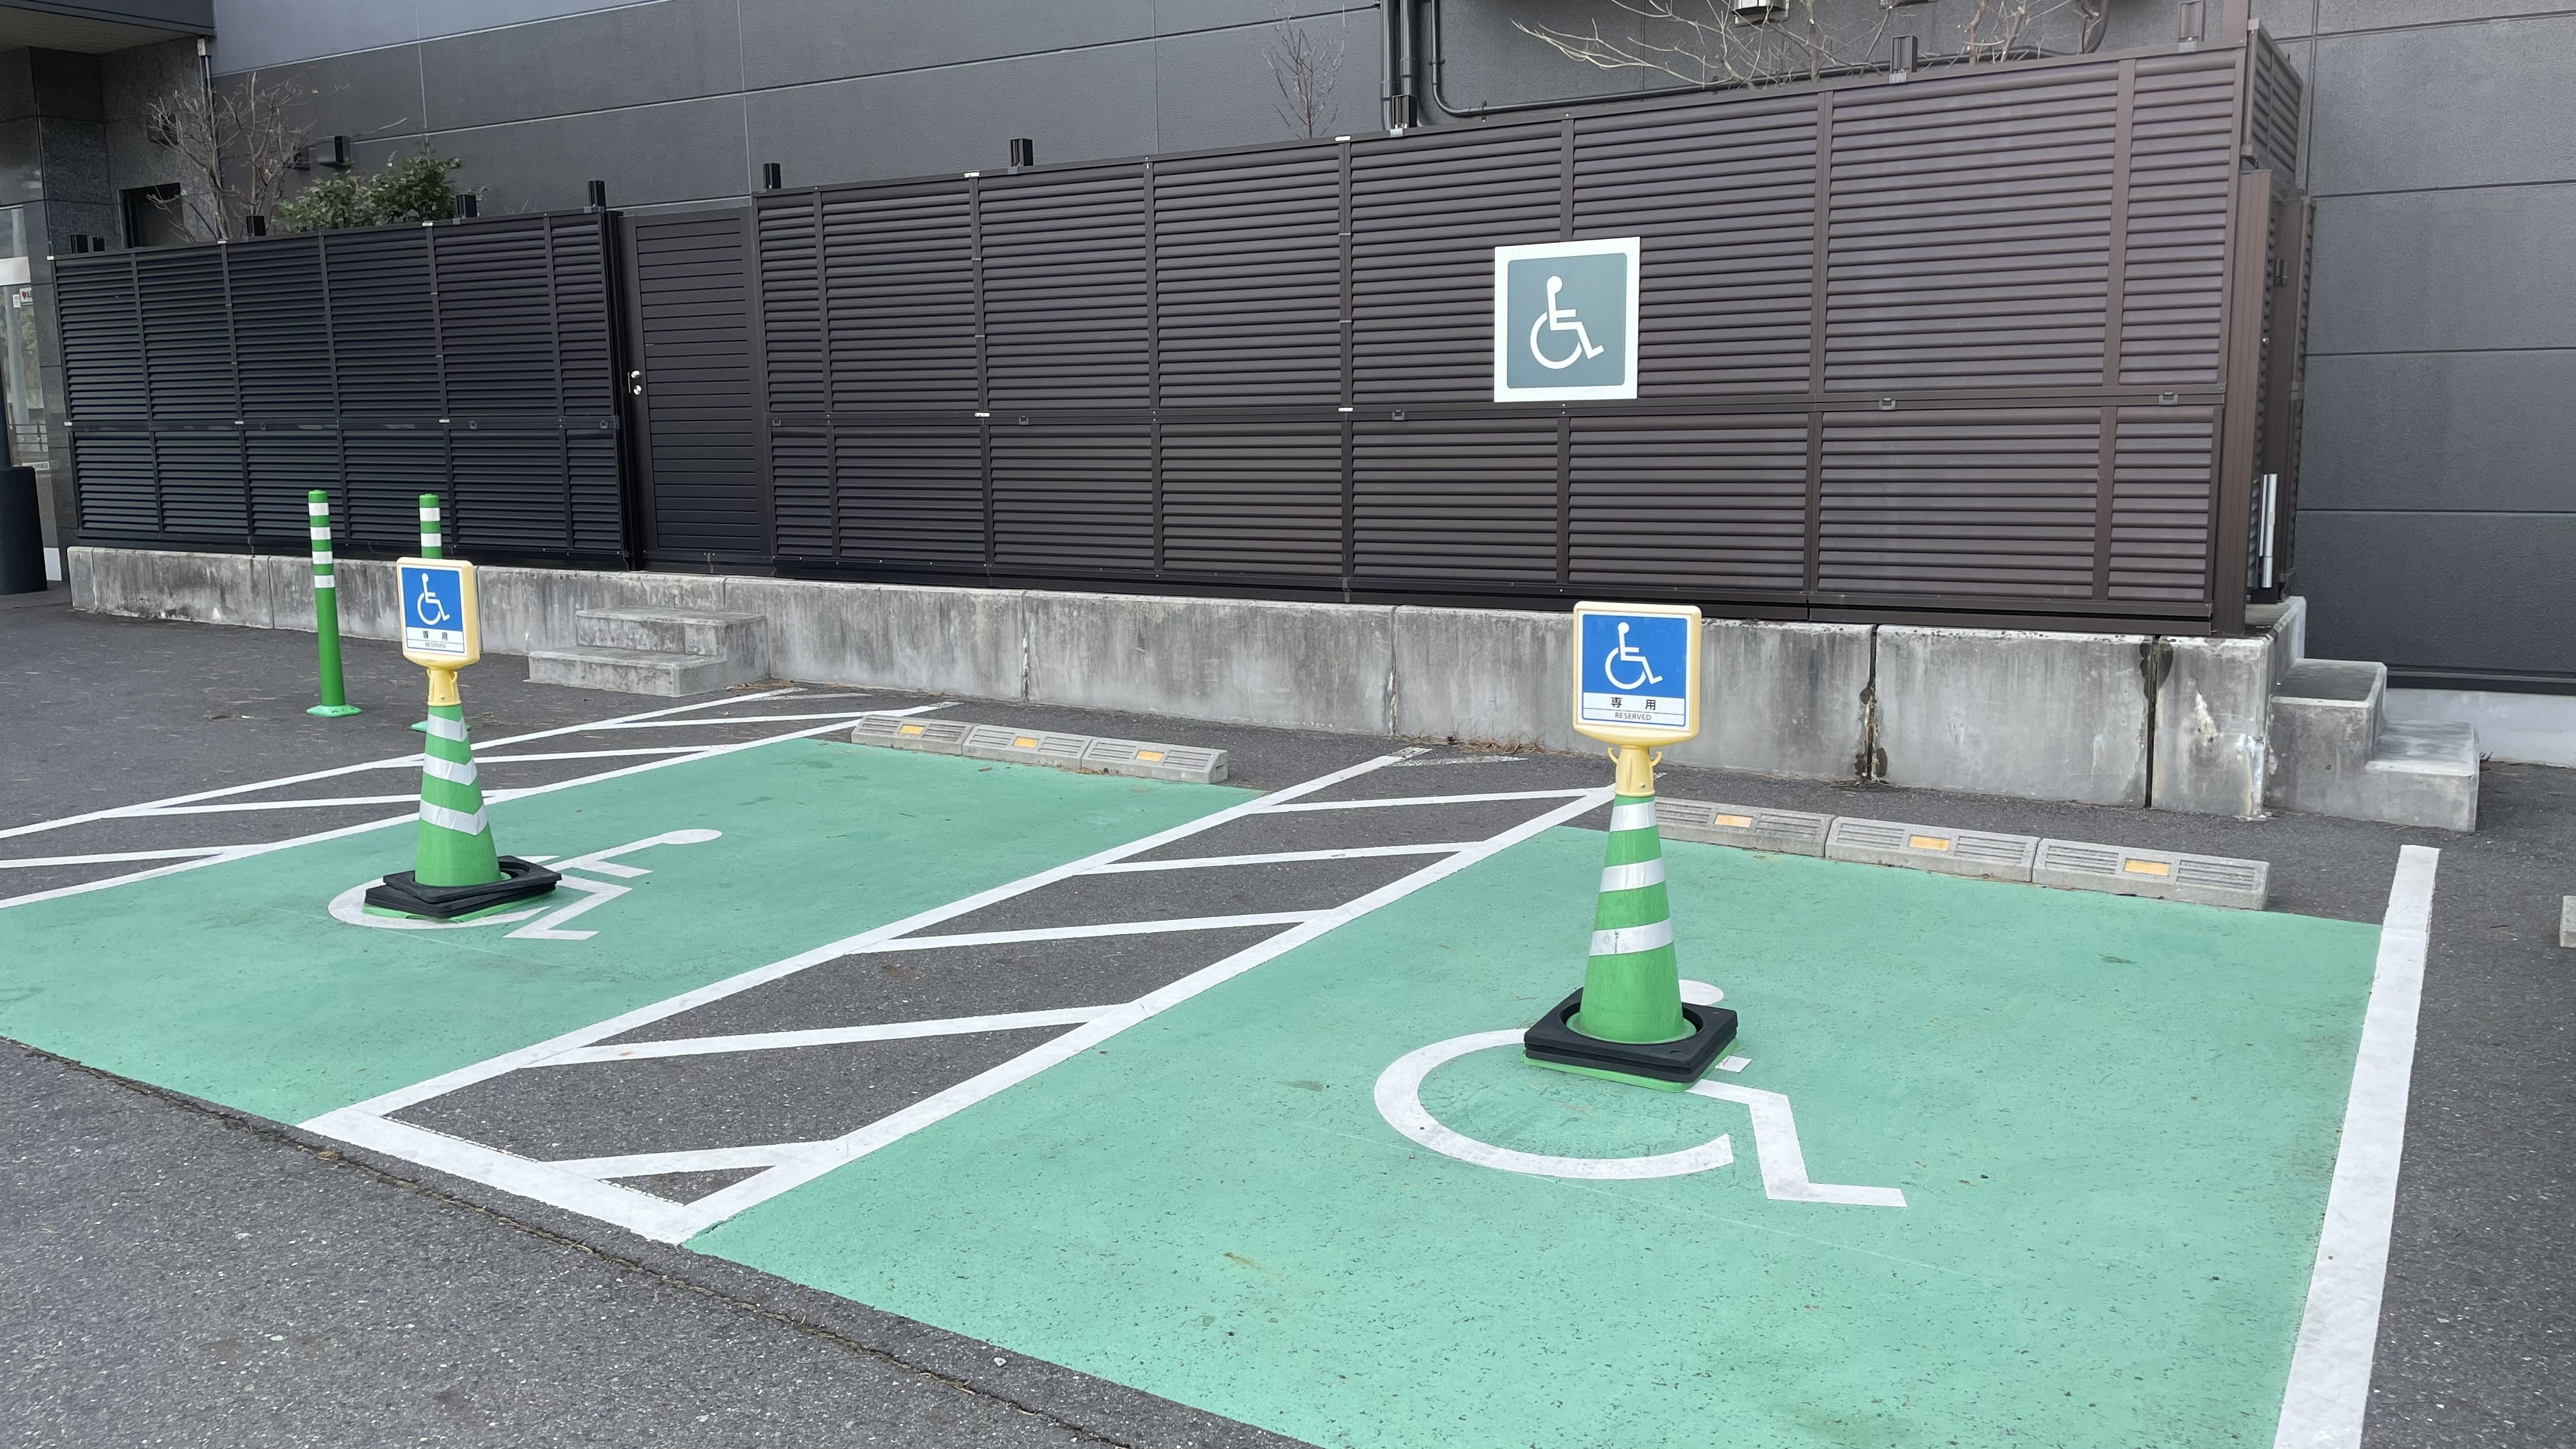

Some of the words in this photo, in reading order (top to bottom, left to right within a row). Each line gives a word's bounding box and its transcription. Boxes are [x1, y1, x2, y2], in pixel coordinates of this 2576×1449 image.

[423, 631, 447, 641] 専用
[1611, 697, 1655, 710] 専用
[1614, 712, 1652, 721] RESERVED
